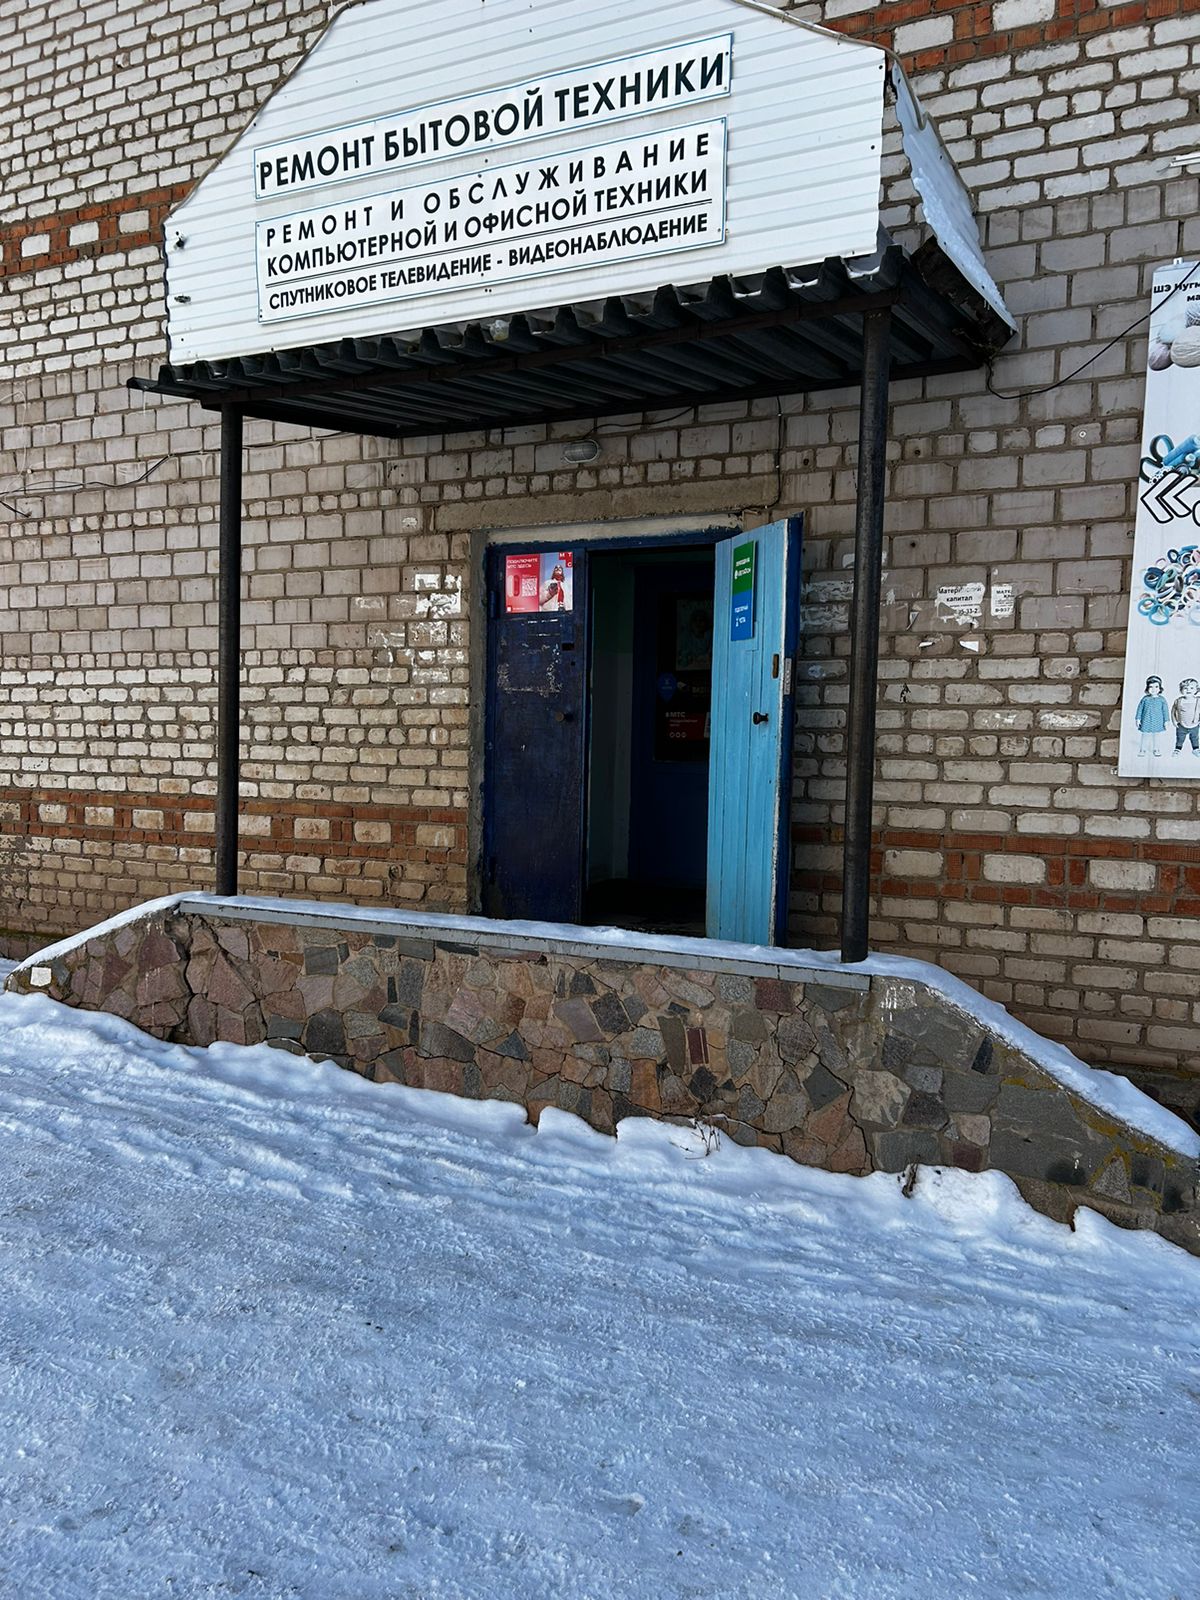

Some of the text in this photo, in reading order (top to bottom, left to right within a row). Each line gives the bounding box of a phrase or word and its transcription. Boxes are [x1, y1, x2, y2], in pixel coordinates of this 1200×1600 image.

[259, 52, 724, 190] РЕМОНТ БЫТОВОЙ ТЕХНИКИ
[266, 133, 709, 248] РЕМОНТ И ОБСЛУЖИВАНИЕ
[267, 168, 708, 277] КОМПЬЮТЕРНОЙ И ОФИСНОЙ ТЕХНИКИ
[268, 274, 377, 310] СПУТНИКОВОЕ
[380, 253, 492, 289] ТЕЛЕВИДЕНИЕ
[508, 213, 708, 267] ВИДЕОНАБЛЮДЕНИЕ
